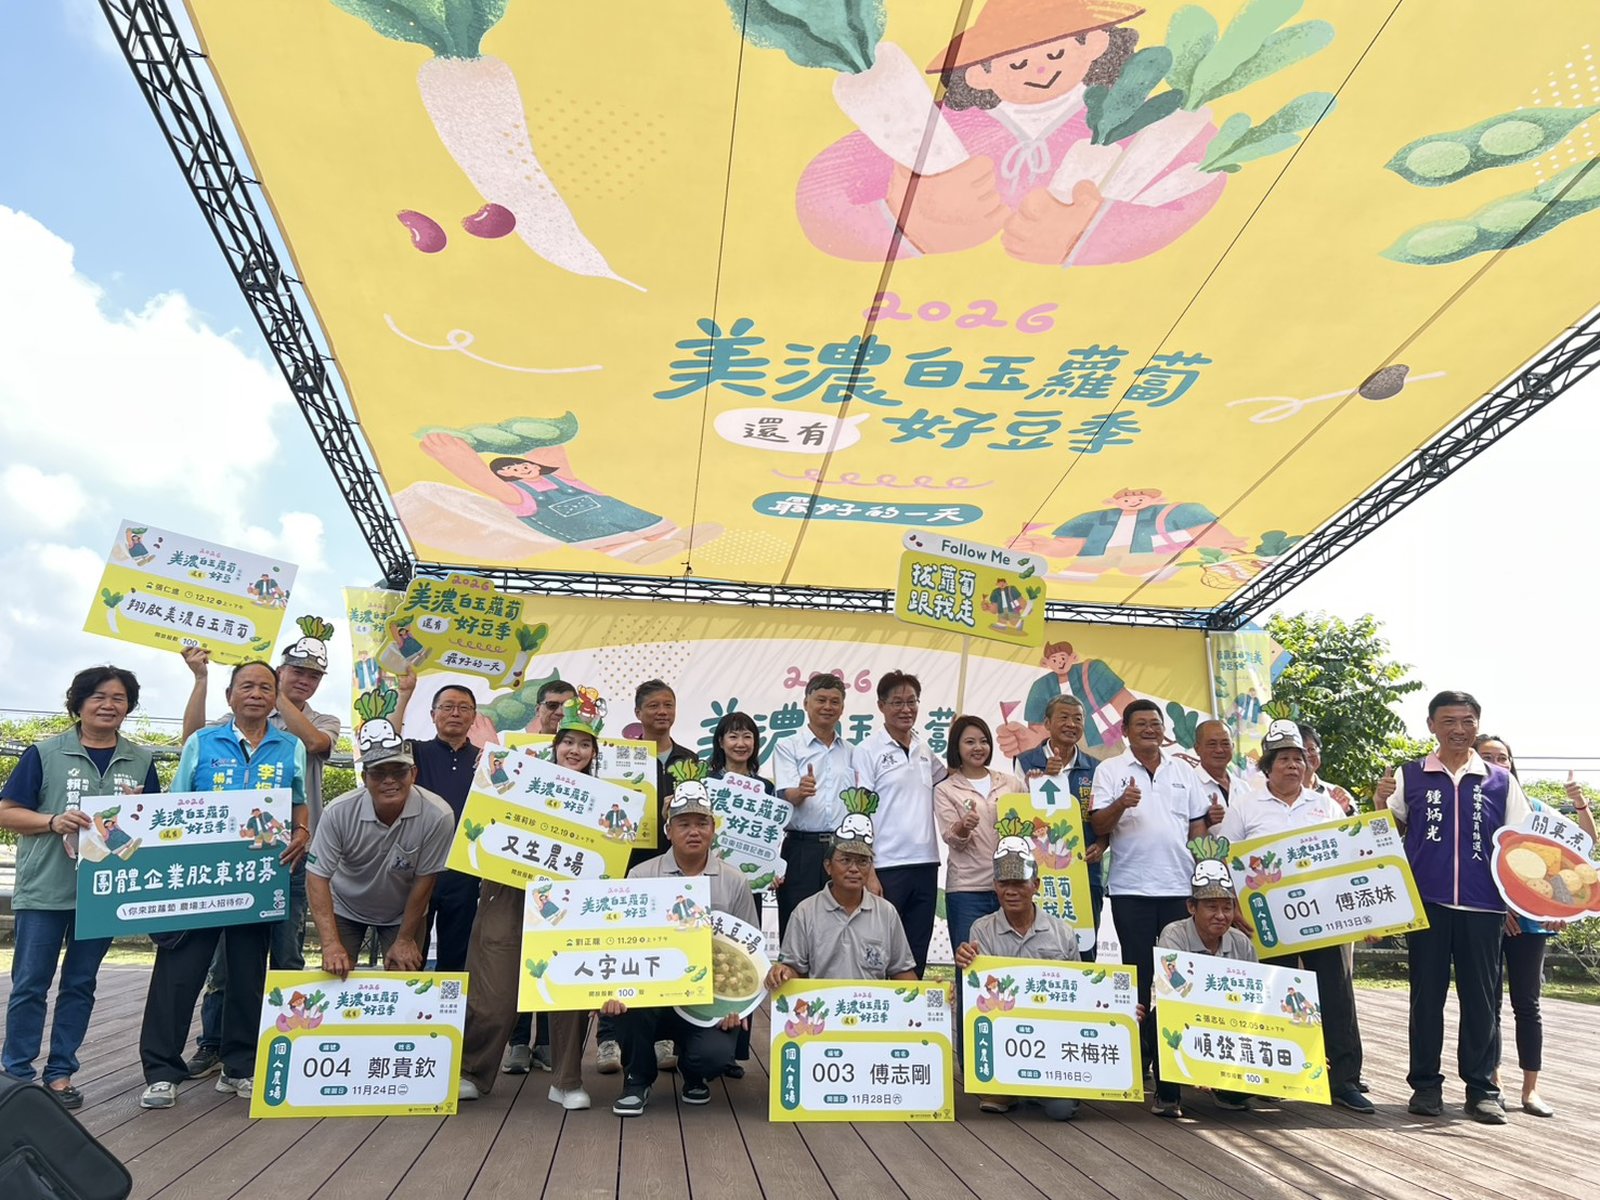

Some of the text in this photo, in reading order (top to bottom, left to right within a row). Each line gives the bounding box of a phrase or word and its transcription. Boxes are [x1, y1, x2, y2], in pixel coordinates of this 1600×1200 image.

[862, 291, 1059, 335] 2026
[653, 317, 1213, 408] 美濃白玉蘿蔔
[742, 417, 824, 447] 還有
[882, 408, 1142, 454] 好豆季
[767, 495, 965, 524] 最好的一天
[941, 539, 1011, 565] Follow Me
[452, 575, 490, 591] 2026
[911, 562, 977, 597] 拔蘿蔔
[404, 582, 521, 620] 美濃白玉蘿蔔
[907, 590, 976, 628] 跟我走
[350, 608, 395, 623] 美濃白玉
[422, 618, 441, 630] 還有
[454, 616, 511, 640] 好豆季
[445, 652, 500, 671] 最好的一天
[525, 776, 590, 804] 美濃白玉蘿蔔
[726, 775, 761, 793] 2026
[177, 798, 205, 806] 2026
[704, 780, 789, 825] 濃白玉蘿蔔
[149, 805, 229, 830] 美濃白玉蘿蔔
[185, 820, 226, 834] 好豆季
[726, 815, 778, 843] 好豆季
[550, 825, 568, 837] 12.19
[501, 835, 584, 876] 又生農場
[93, 856, 277, 895] 團體企業股東招募
[1036, 876, 1070, 898] 蘿蔔
[580, 893, 649, 916] 美濃白玉蘿蔔
[1043, 900, 1077, 920] 我走
[1283, 899, 1320, 920] 001
[617, 936, 638, 944] 11.29
[574, 953, 661, 980] 人字山下
[335, 991, 399, 1010] 美濃白玉蘿蔔
[618, 989, 634, 997] 100
[1049, 992, 1077, 1003] 好豆季
[363, 1004, 396, 1016] 好豆季
[860, 1012, 888, 1023] 好豆季
[978, 1022, 990, 1076] 個人農場
[1005, 1038, 1120, 1065] 002 宋梅祥
[1194, 1033, 1292, 1067] 順發蘿蔔田
[268, 1043, 287, 1099] 個人農場
[303, 1056, 436, 1080] 004 鄭貴欽
[785, 1048, 797, 1103] 個人農場
[812, 1063, 930, 1085] 003 傅志剛
[1246, 1074, 1260, 1083] 100
